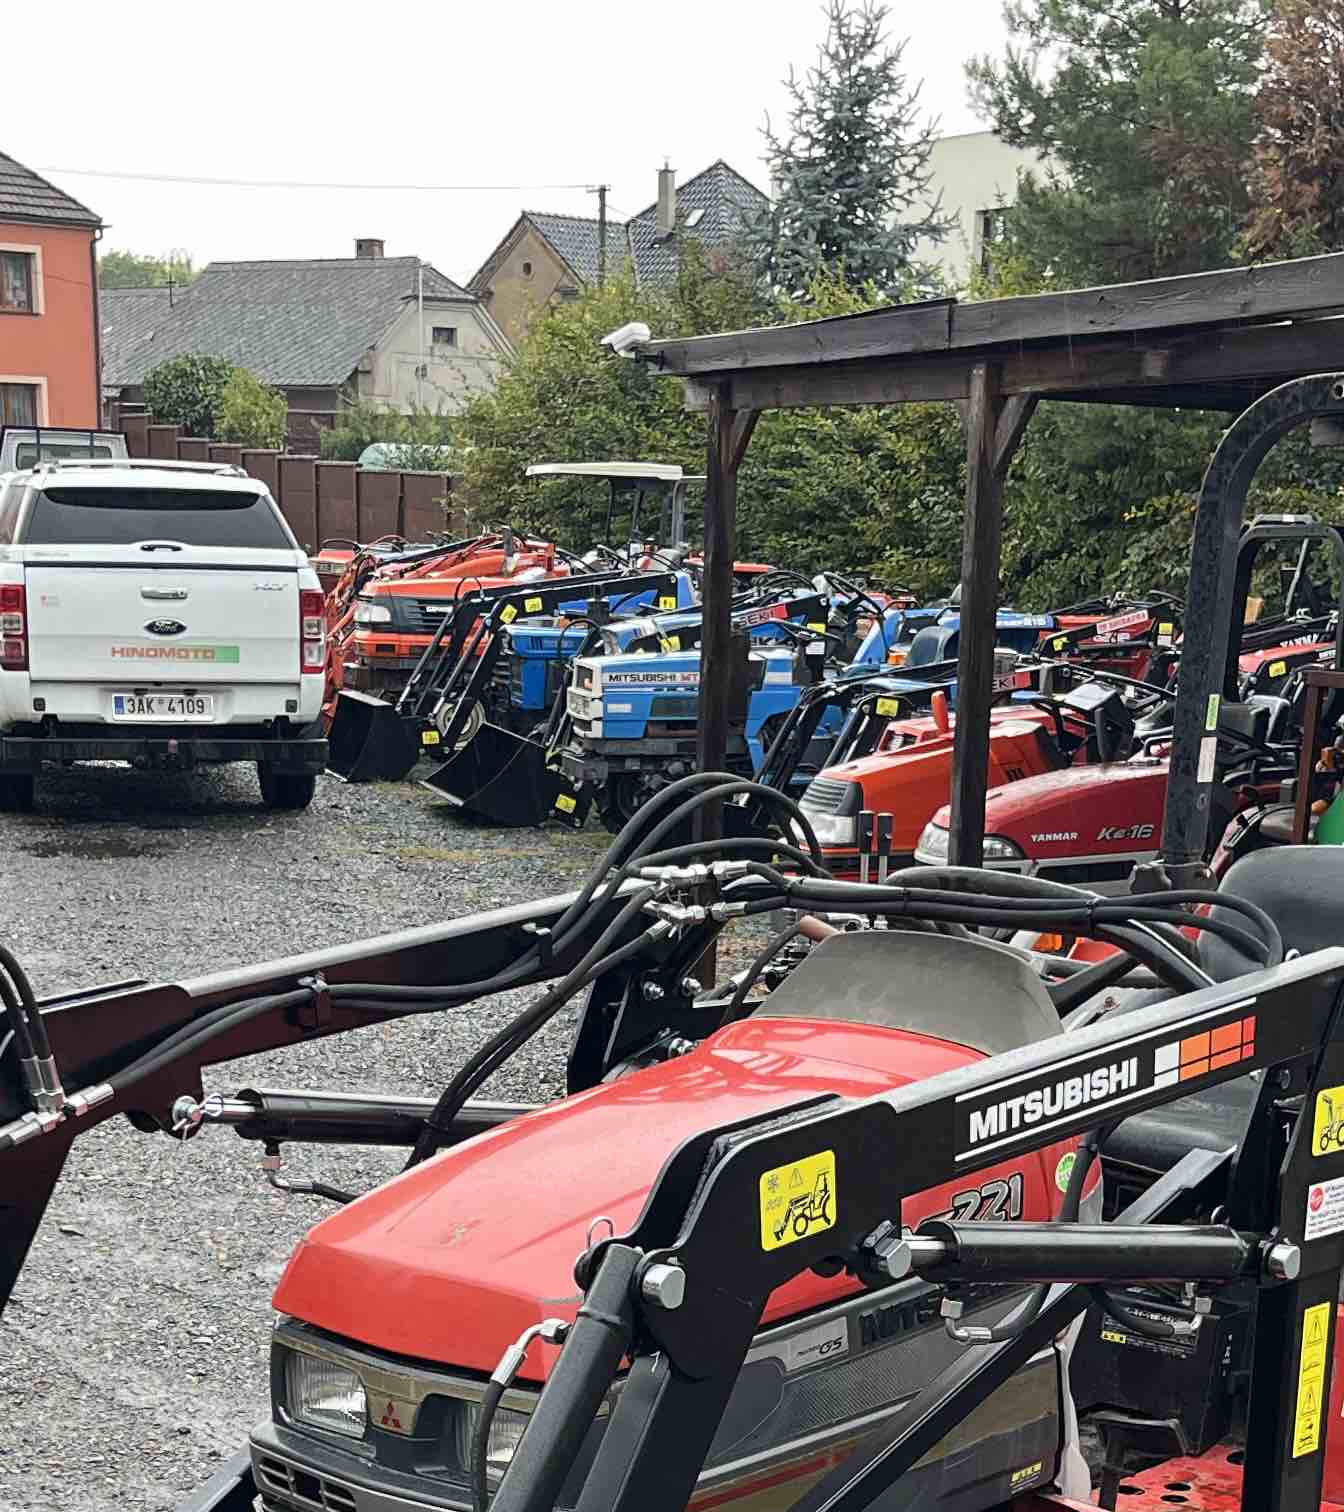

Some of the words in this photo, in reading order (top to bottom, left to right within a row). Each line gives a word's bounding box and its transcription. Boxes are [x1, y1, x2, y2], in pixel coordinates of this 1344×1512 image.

[111, 646, 216, 660] HINOMOTO
[608, 673, 676, 683] MITSUBISHI
[127, 698, 155, 715] 3AK
[167, 698, 205, 715] 4109
[1030, 832, 1079, 843] YANMAR
[968, 1056, 1139, 1144] MITSUBISHI
